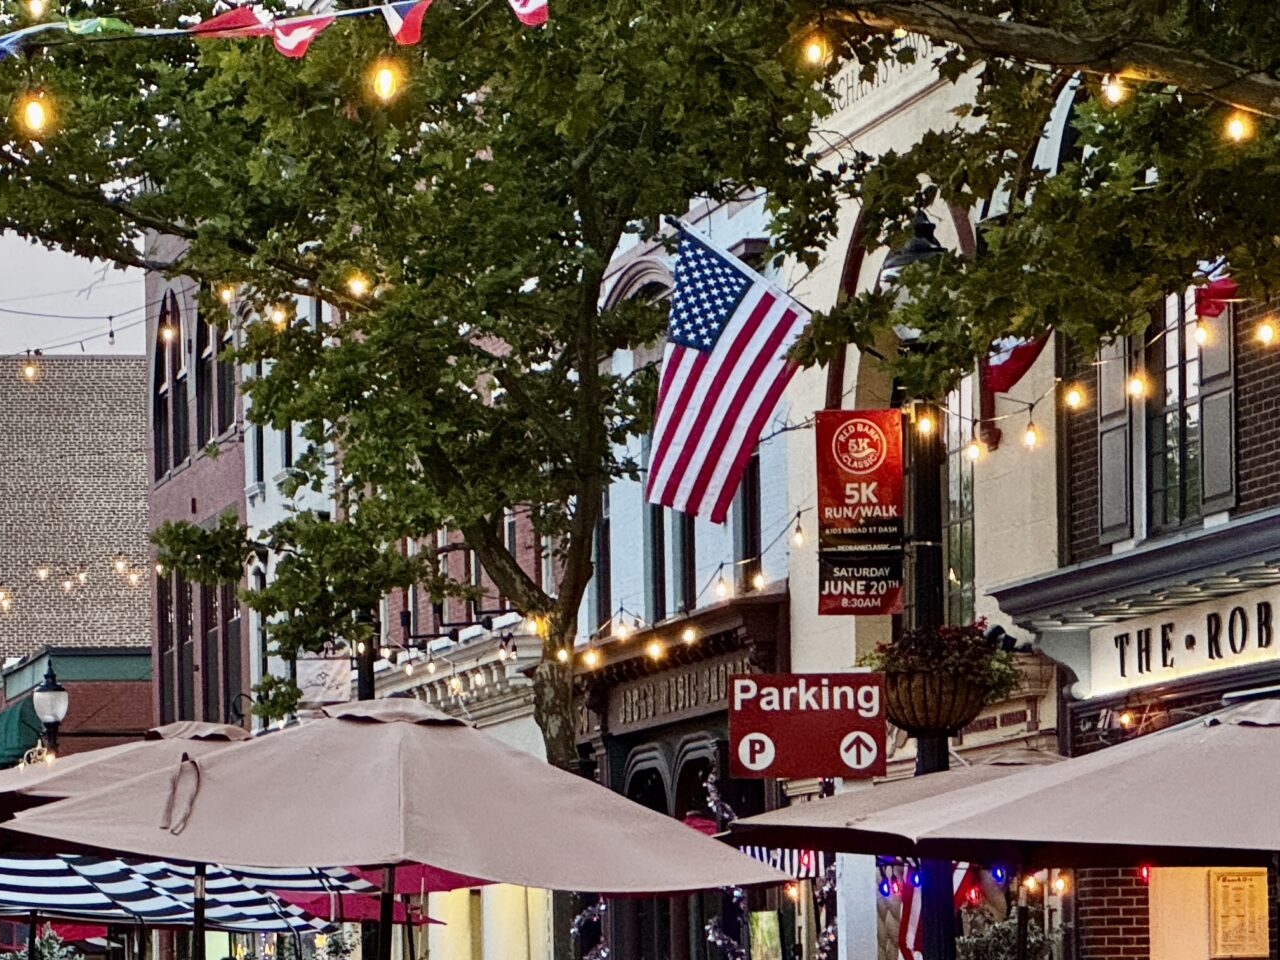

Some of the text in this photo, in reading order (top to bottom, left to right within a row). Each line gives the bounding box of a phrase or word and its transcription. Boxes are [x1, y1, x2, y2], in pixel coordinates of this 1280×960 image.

[838, 423, 880, 443] RED BANK
[848, 438, 870, 452] 5K
[842, 454, 877, 469] CLASSIC
[844, 482, 879, 504] 5K
[824, 505, 898, 519] RUN/WALK
[833, 566, 891, 577] SATURDAY
[821, 580, 866, 596] JUNE
[841, 598, 881, 608] 8:30AM
[1114, 622, 1175, 678] THE
[733, 678, 880, 718] Parking
